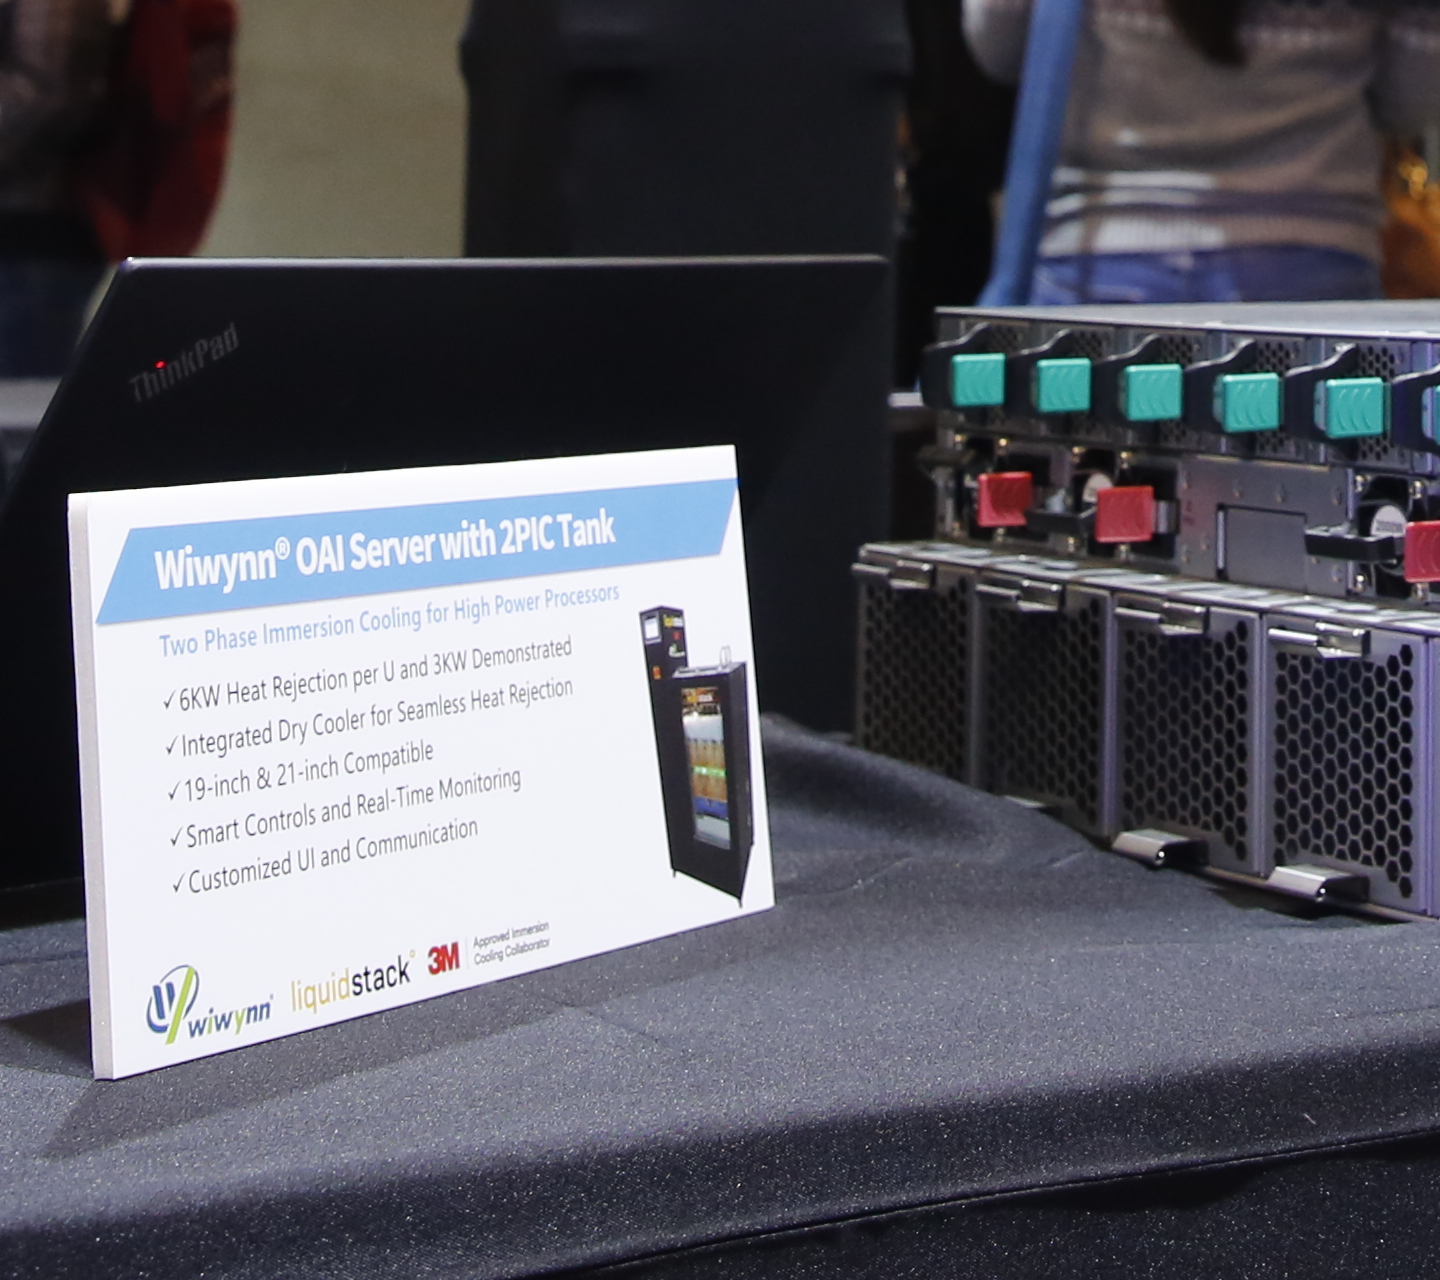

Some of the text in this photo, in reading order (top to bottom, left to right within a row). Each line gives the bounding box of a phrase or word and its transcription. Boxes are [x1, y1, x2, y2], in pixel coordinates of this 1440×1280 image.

[128, 323, 241, 403] ThinkPad
[296, 533, 345, 576] OAI
[349, 531, 437, 572] Server
[439, 518, 497, 562] with
[499, 514, 556, 555] 2PIC
[556, 507, 617, 549] Tank
[159, 585, 620, 658] Two Phase Immersion Cooling for High Power Processors
[179, 634, 573, 711] 6KW Heat Rejection per U and 3KW Demonstrated
[182, 677, 574, 759] Integrated Dry Cooler for Seamless Heat Rejection
[184, 739, 434, 802] 19-inch & 21-inch Compatible
[186, 767, 522, 849] Smart Controls and Real-Time Monitoring
[188, 817, 479, 894] Customized UI and Communication
[428, 941, 460, 976] 3M
[473, 920, 550, 951] Approved Immersion
[474, 936, 550, 966] Cooling Collaborator
[290, 954, 411, 1014] liquidstack
[188, 1000, 271, 1039] wiwynn
